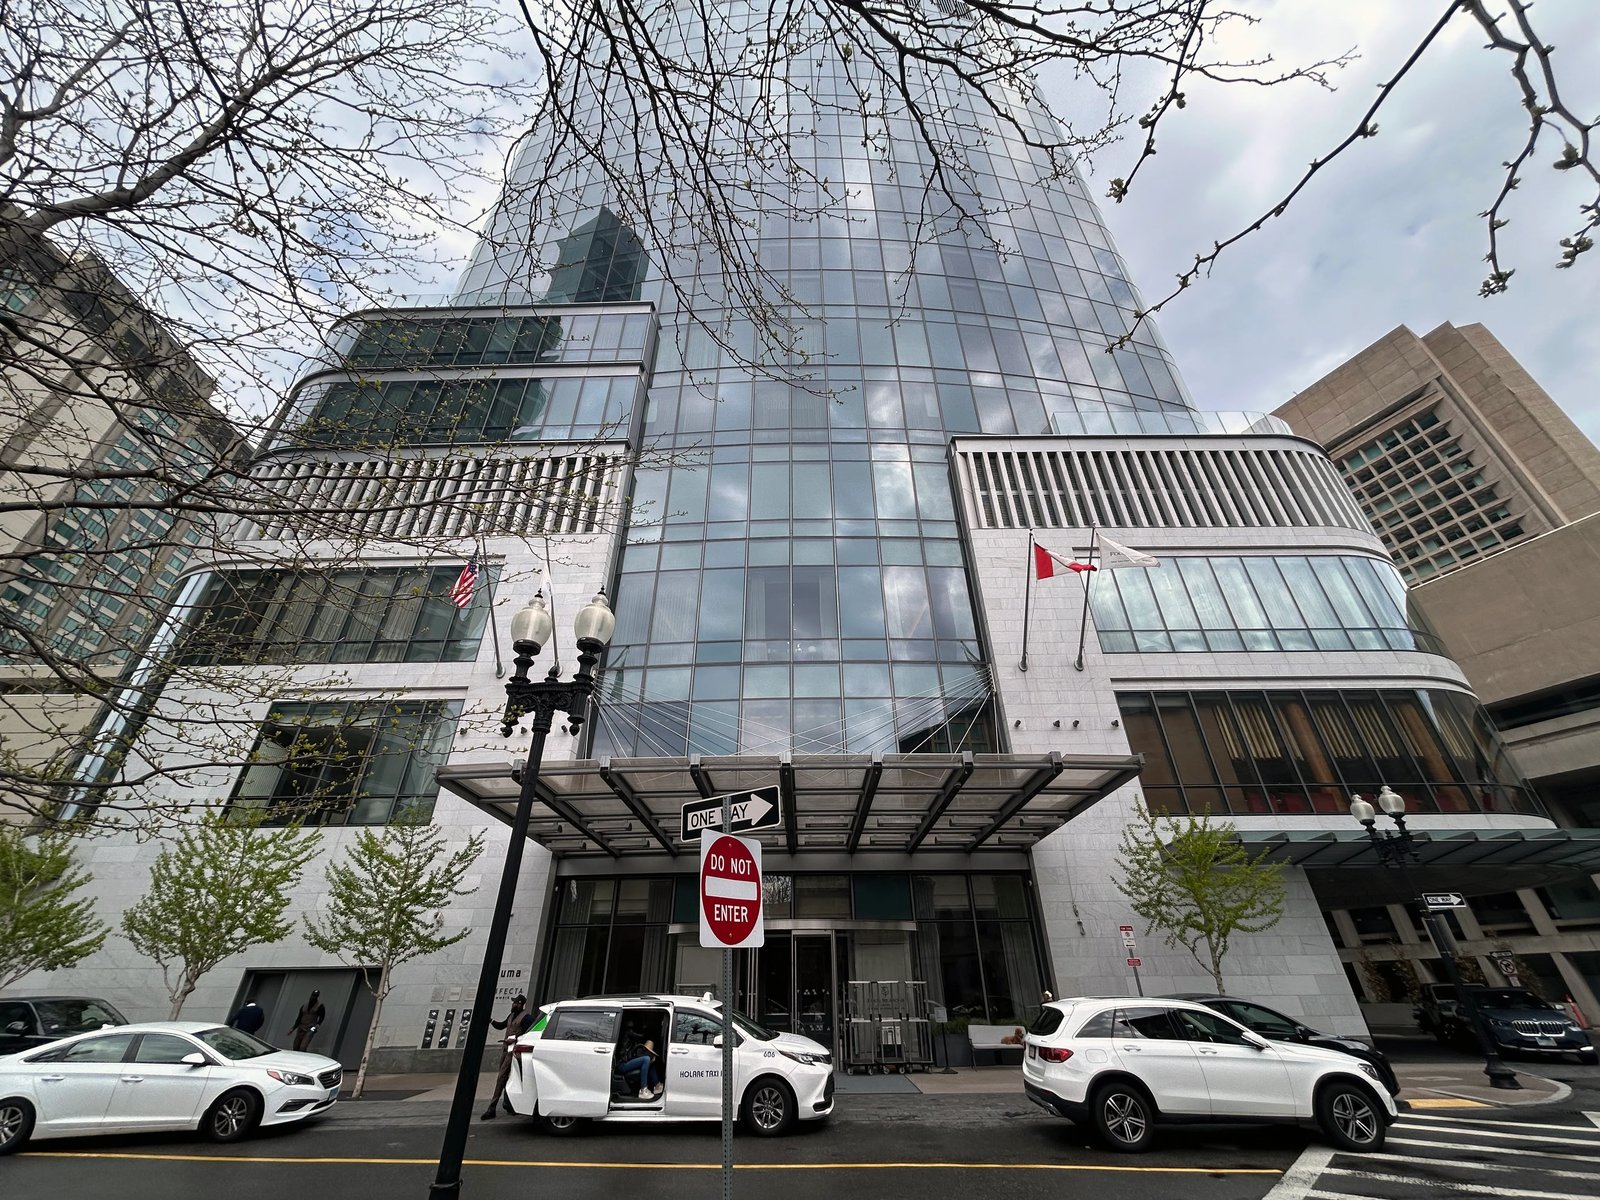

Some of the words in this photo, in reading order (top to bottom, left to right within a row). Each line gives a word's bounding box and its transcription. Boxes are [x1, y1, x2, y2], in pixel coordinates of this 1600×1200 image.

[691, 810, 715, 828] ONE
[721, 804, 748, 822] AY
[710, 854, 725, 872] DO
[730, 858, 752, 875] NOT
[714, 904, 749, 923] ENTER
[501, 970, 521, 978] uma
